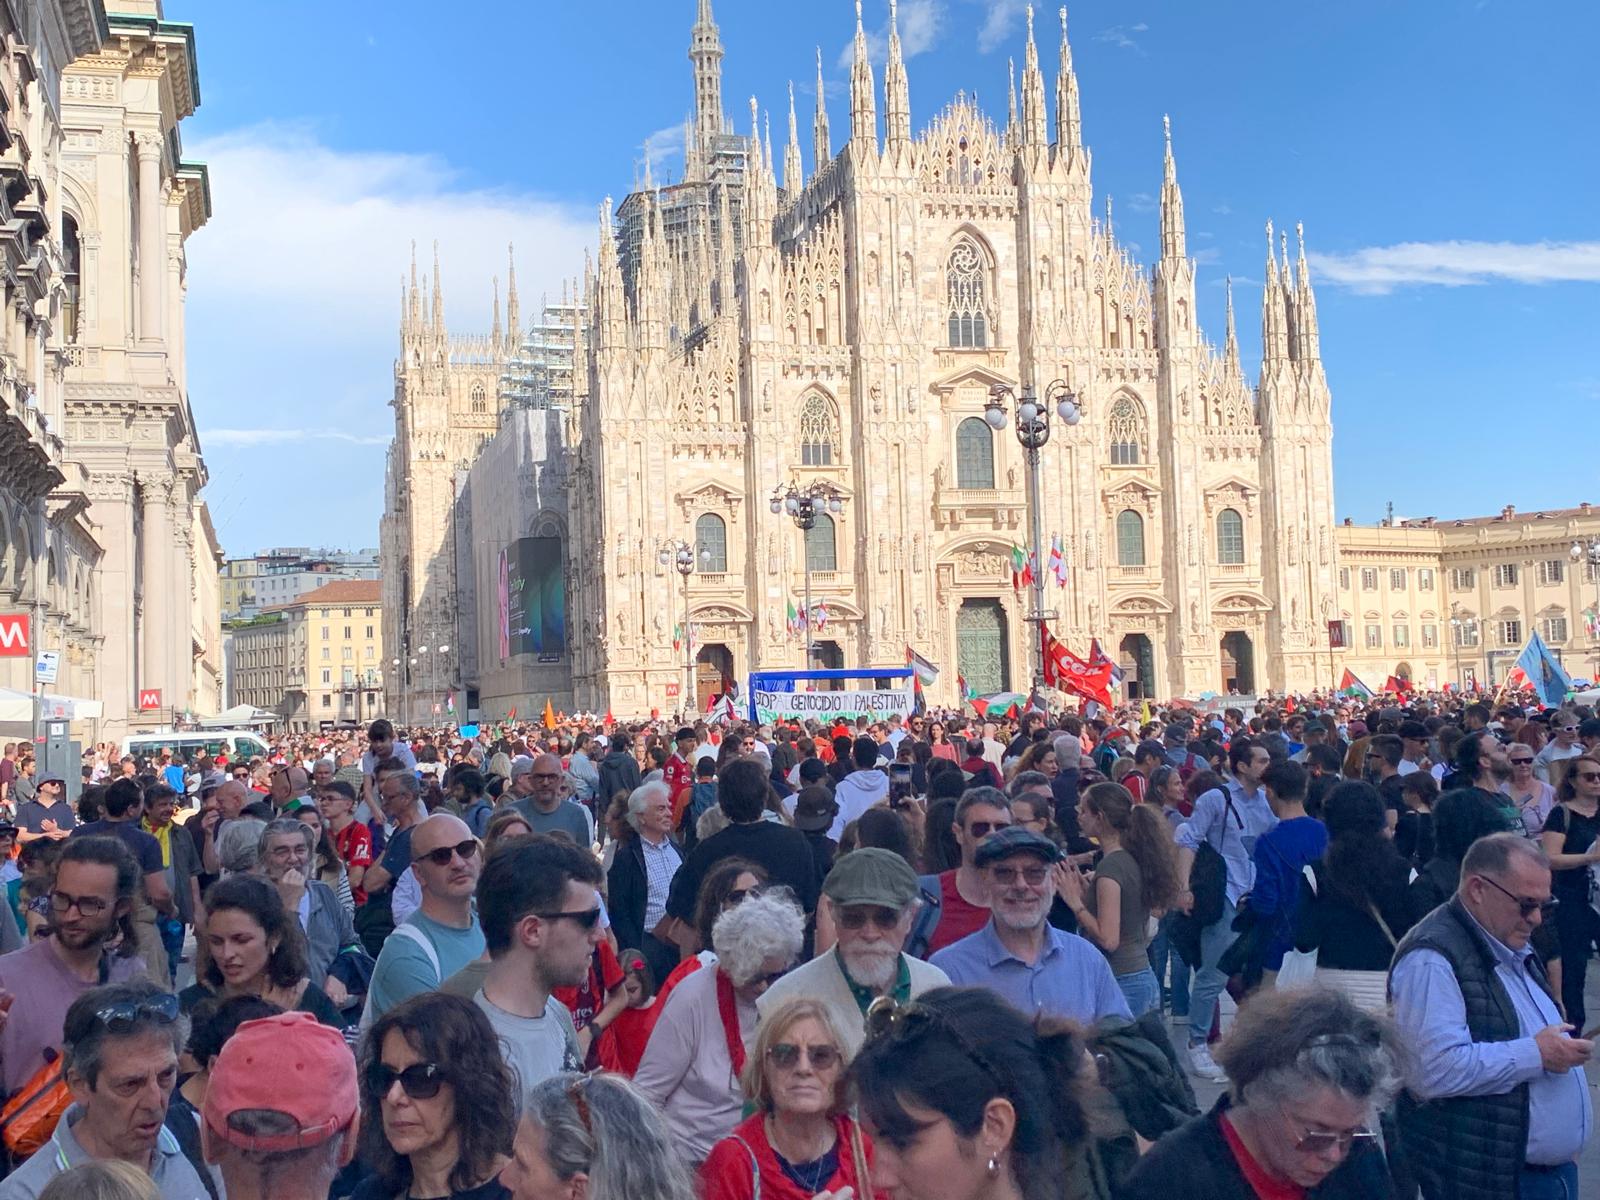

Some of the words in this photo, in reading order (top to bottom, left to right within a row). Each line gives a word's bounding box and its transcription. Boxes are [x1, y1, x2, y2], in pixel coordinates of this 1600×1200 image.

[0, 622, 27, 648] M
[668, 686, 678, 695] M
[143, 693, 159, 705] M
[756, 692, 777, 710] STOP
[791, 695, 841, 711] GENOCIDIO
[855, 694, 907, 711] PALESTINA
